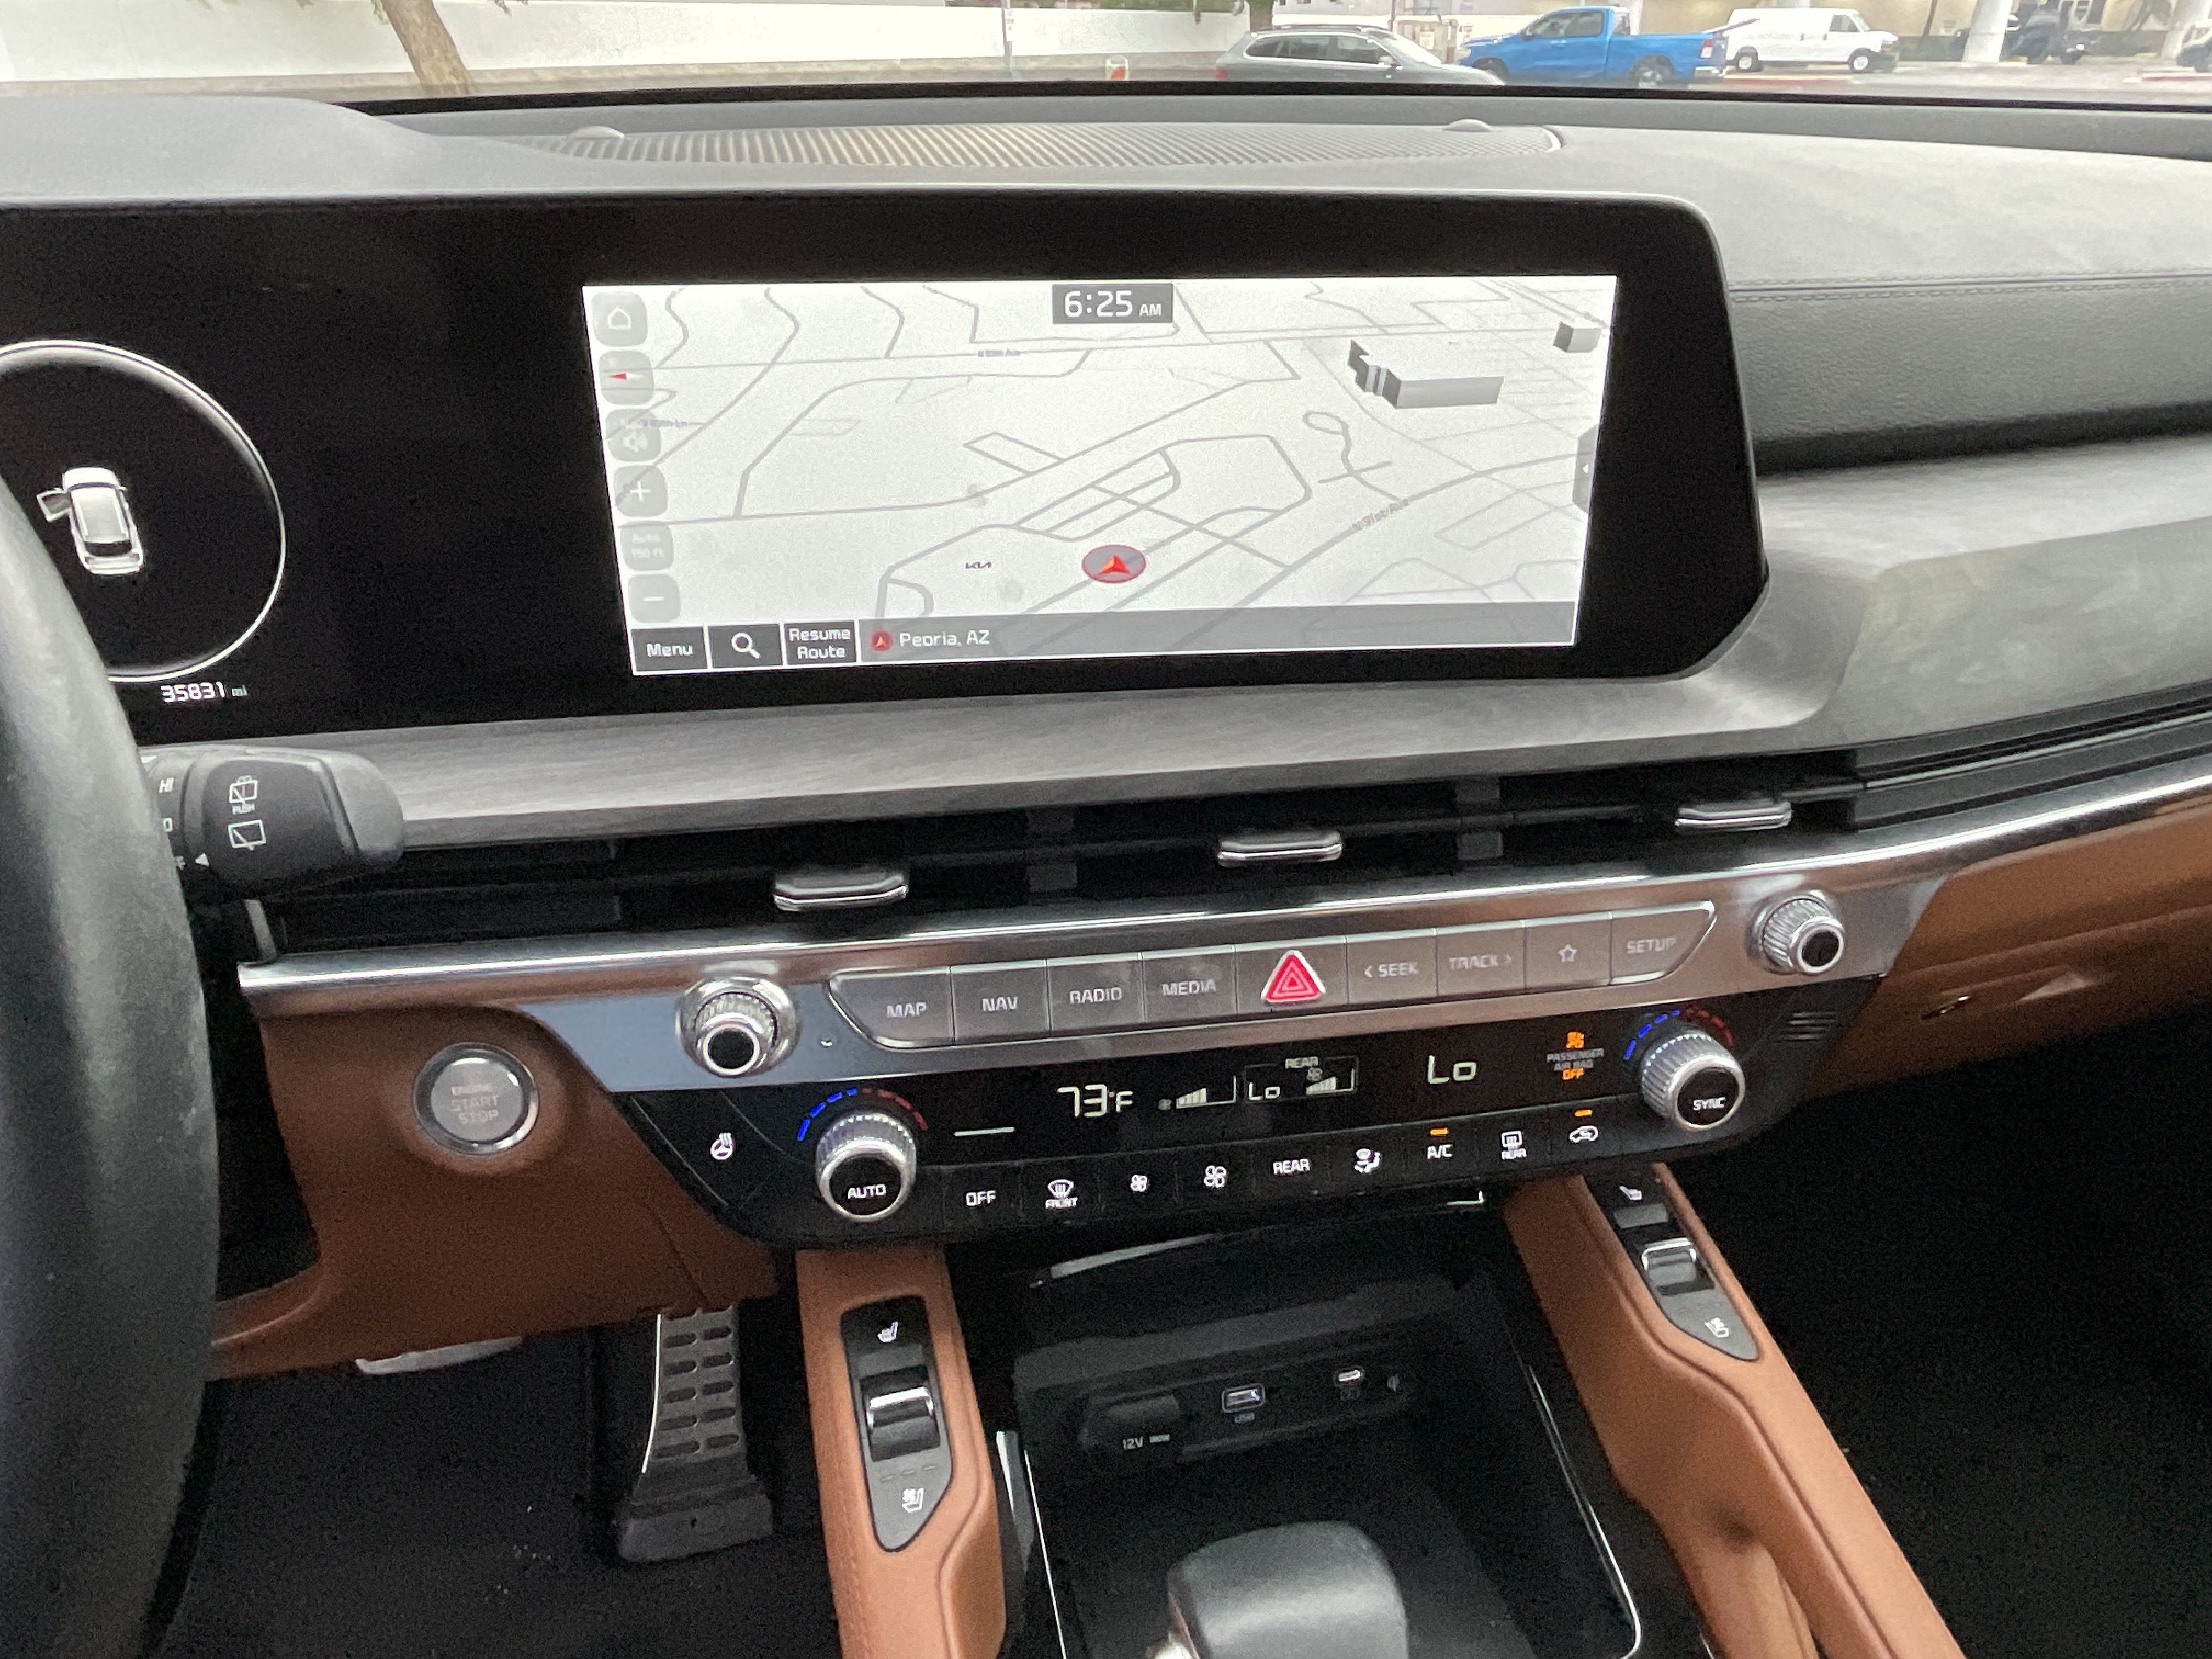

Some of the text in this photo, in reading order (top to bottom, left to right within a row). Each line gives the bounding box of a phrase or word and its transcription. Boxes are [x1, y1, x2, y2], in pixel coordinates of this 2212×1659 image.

[1064, 290, 1163, 318] 6:25 AM
[788, 628, 851, 642] Resume
[966, 630, 990, 645] AZ
[646, 642, 693, 657] Menu
[797, 645, 846, 659] Route
[160, 681, 226, 702] 35831
[159, 777, 174, 793] HI
[1626, 937, 1677, 955] SETUP
[1378, 962, 1419, 978] SEEK
[1448, 955, 1499, 970] TRACK
[1070, 986, 1122, 1004] RADIO
[1161, 979, 1217, 996] MEDIA
[886, 1001, 927, 1017] MAP
[981, 995, 1018, 1012] NAV
[1426, 1054, 1477, 1084] Lo
[1562, 1068, 1585, 1081] OFF
[1248, 1082, 1281, 1101] Lo
[1692, 1096, 1726, 1111] SYNC
[1427, 1143, 1453, 1160] A/C
[1500, 1147, 1527, 1160] REAR
[1273, 1158, 1311, 1176] REAR
[847, 1183, 887, 1200] AUTO
[965, 1190, 997, 1207] OFF
[1045, 1197, 1079, 1209] FRONT
[1122, 1435, 1144, 1451] 12V
